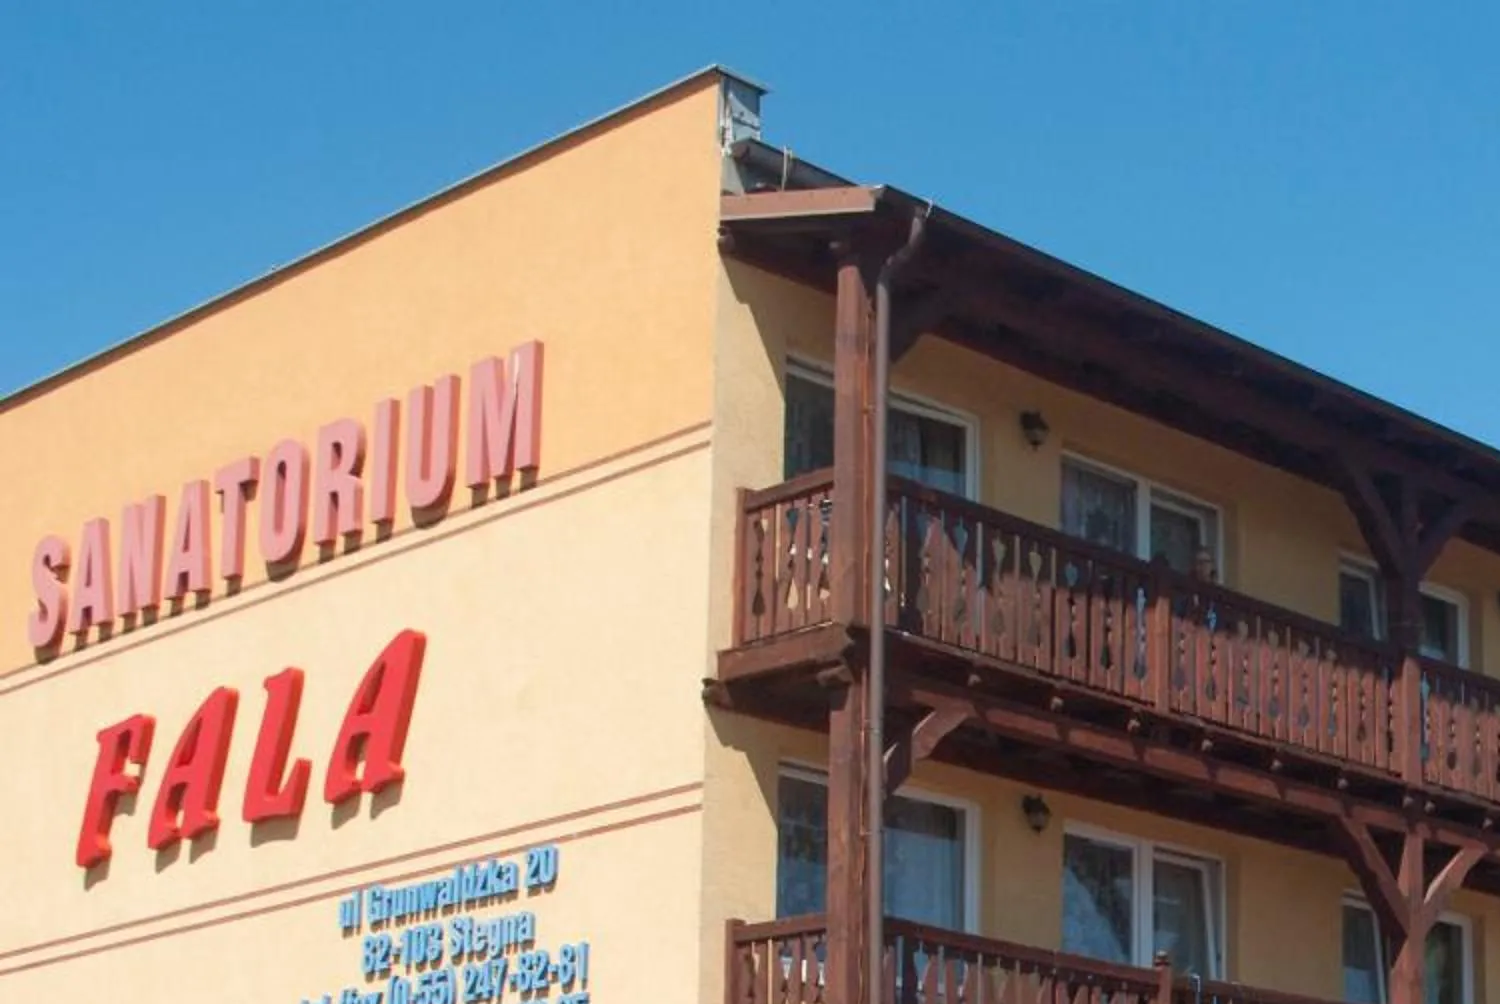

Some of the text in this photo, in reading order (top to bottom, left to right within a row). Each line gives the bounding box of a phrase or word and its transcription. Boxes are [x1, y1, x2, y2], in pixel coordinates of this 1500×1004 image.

[27, 340, 544, 649] SANATORIUM
[76, 628, 427, 869] FALA
[367, 860, 519, 924] Grunwaldzka
[525, 846, 559, 887] 20
[362, 912, 535, 972] 82-103 Stegna
[463, 941, 589, 1002] 247-82-81
